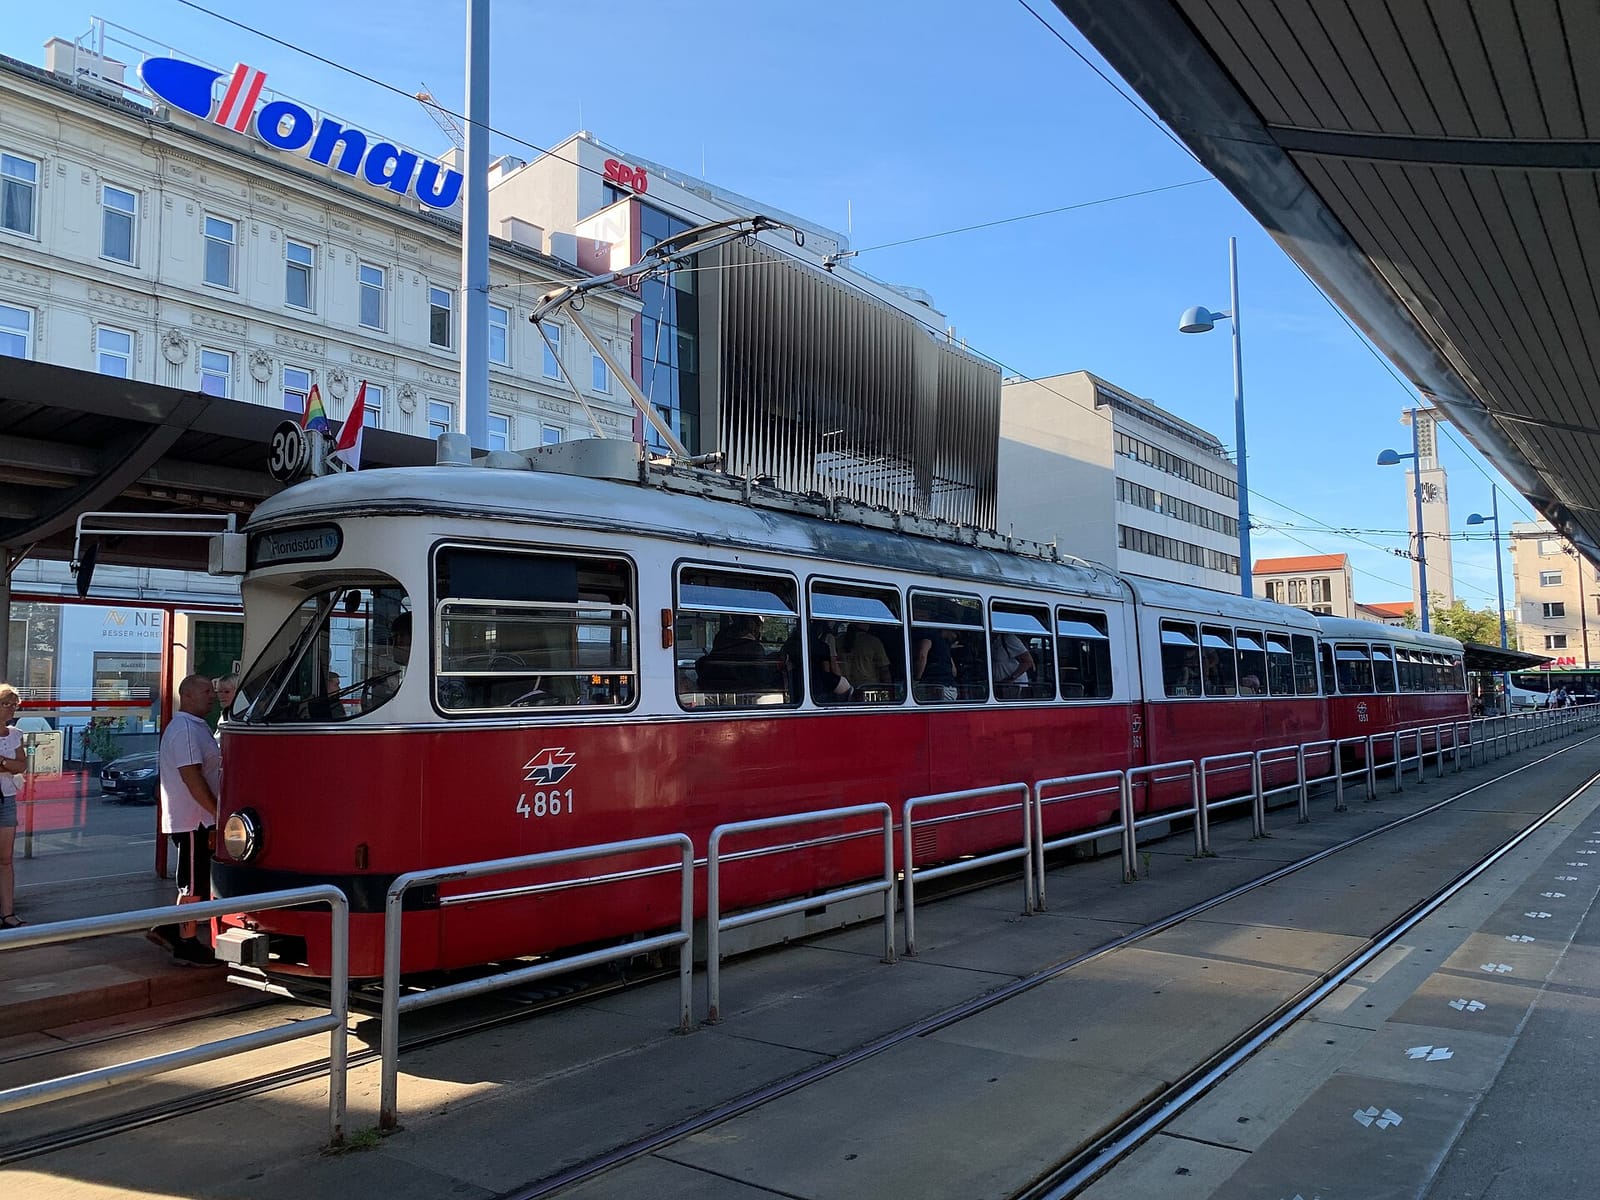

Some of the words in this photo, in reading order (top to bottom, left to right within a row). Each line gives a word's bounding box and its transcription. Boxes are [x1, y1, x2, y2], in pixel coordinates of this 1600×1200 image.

[602, 158, 648, 195] SPÖ
[271, 430, 298, 472] 30
[102, 629, 134, 638] BESSER
[136, 630, 163, 639] HÖRE
[516, 788, 574, 819] 4861
